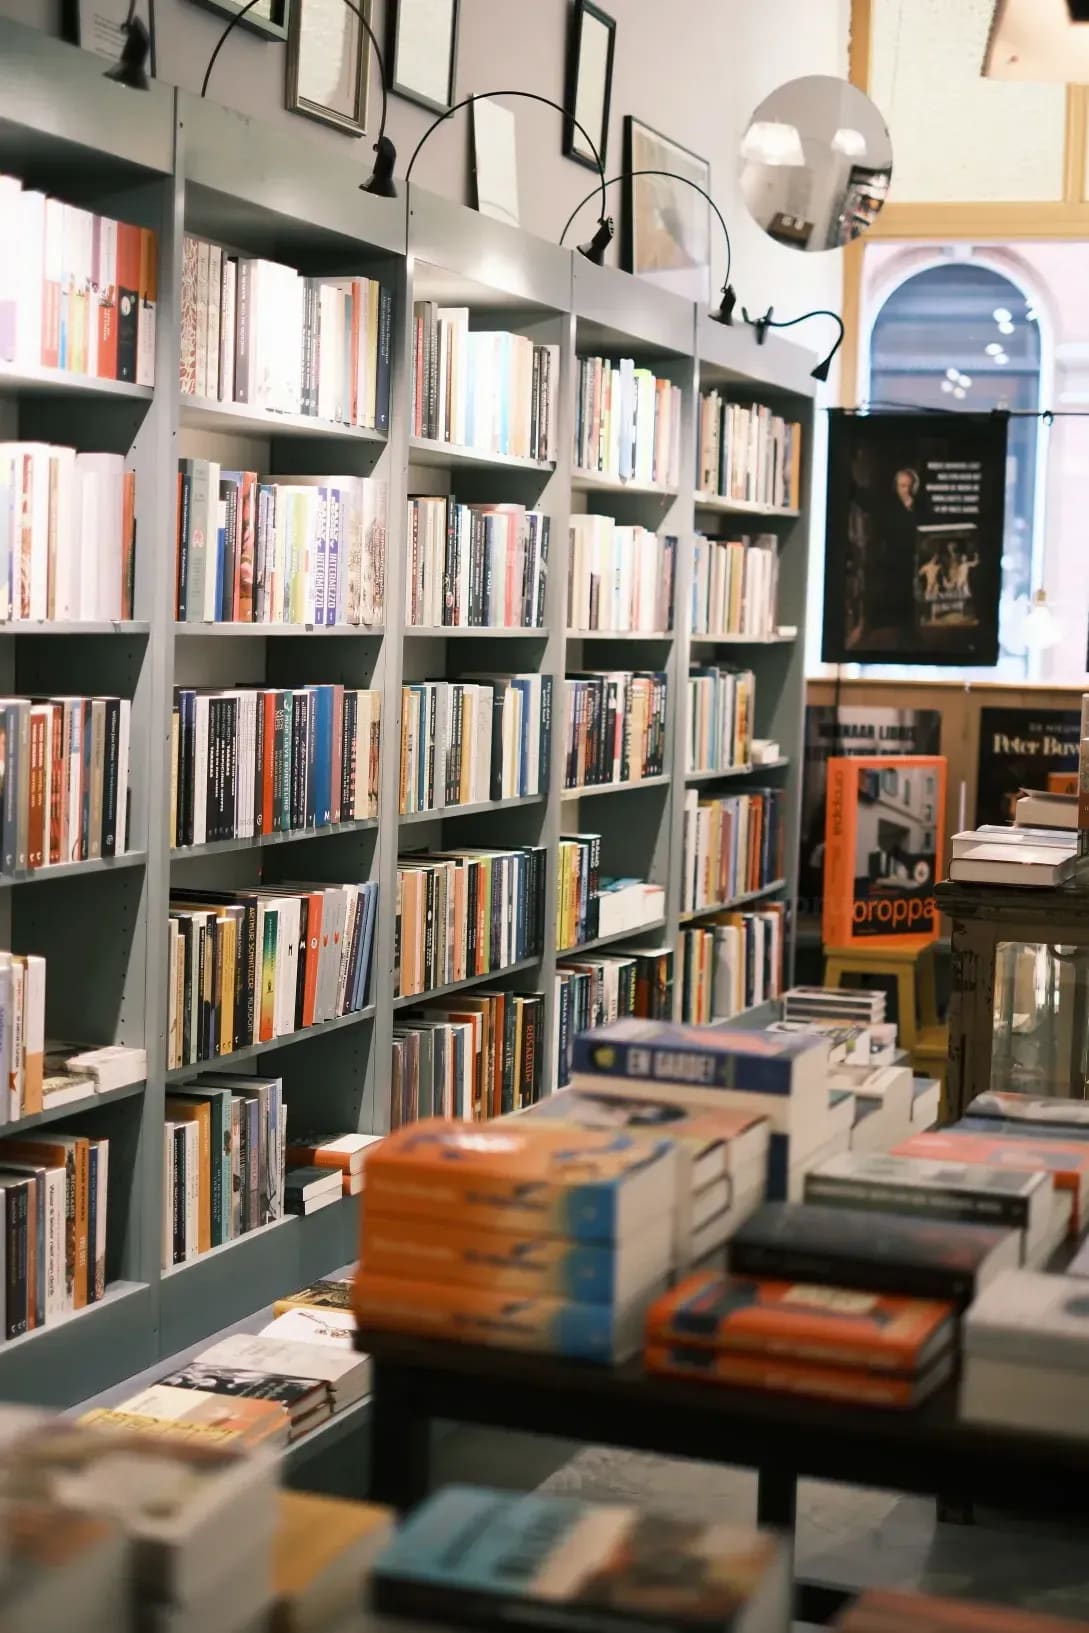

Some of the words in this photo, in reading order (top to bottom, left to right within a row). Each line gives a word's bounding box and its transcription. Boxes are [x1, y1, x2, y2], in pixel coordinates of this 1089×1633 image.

[316, 552, 325, 608] INTERMEZZO
[329, 553, 337, 608] INTERMEZZO
[993, 733, 1040, 754] Peter
[854, 898, 937, 928] oroppa
[525, 1025, 534, 1083] ROSARIUM
